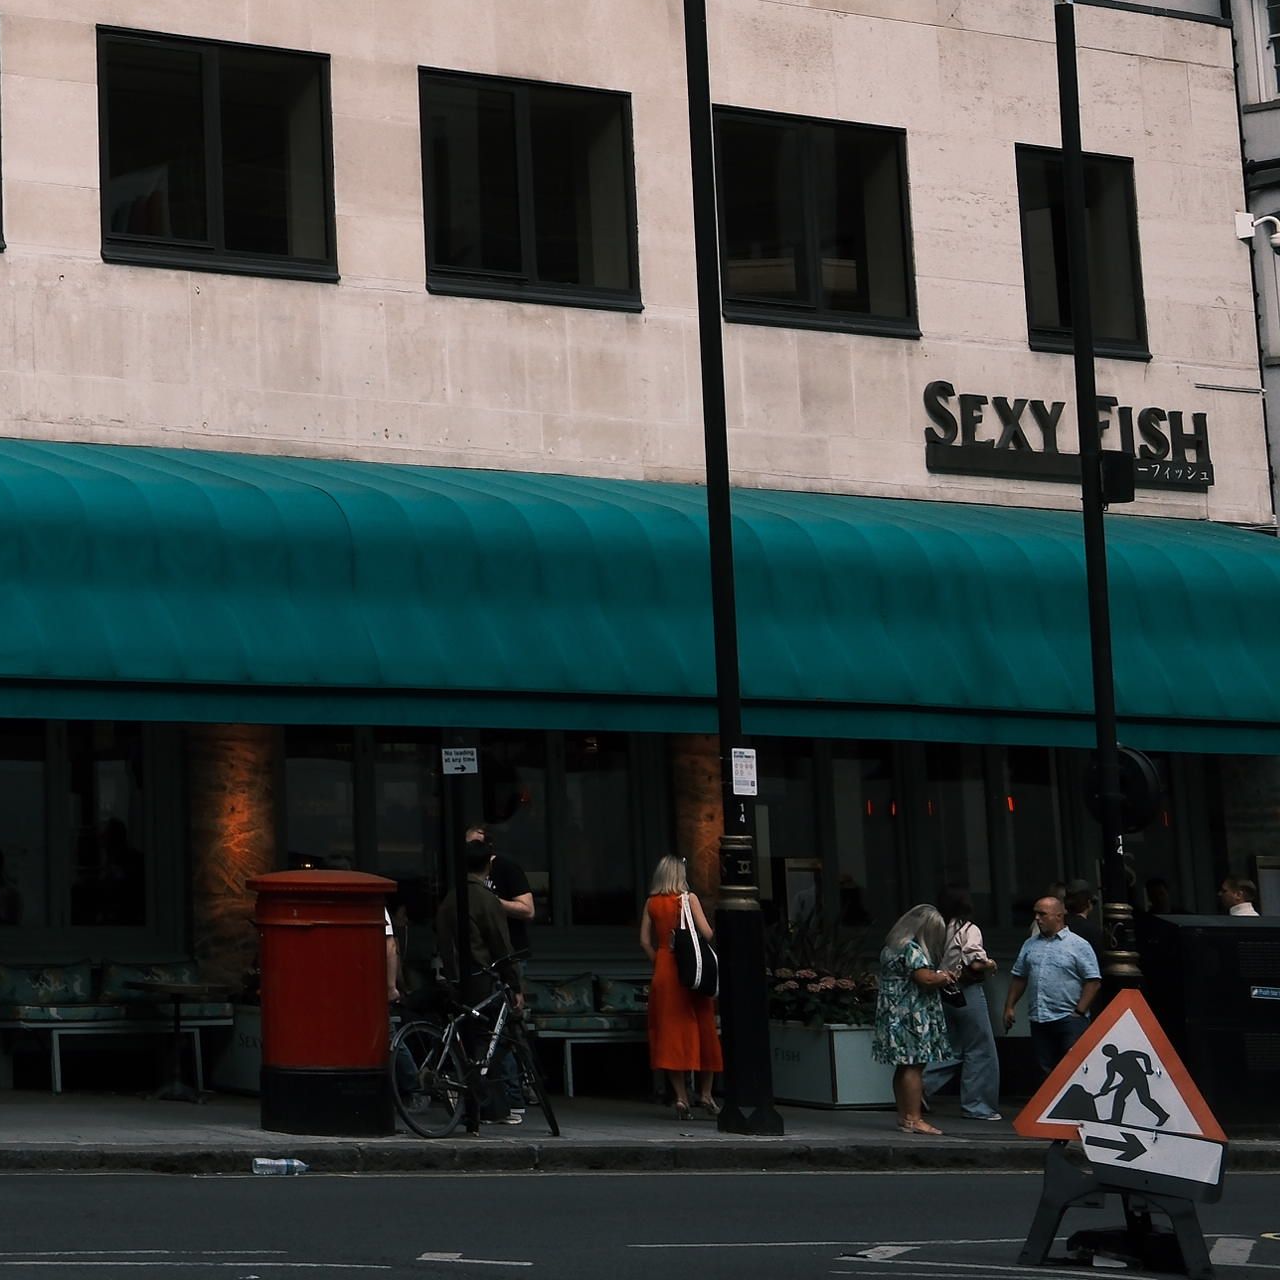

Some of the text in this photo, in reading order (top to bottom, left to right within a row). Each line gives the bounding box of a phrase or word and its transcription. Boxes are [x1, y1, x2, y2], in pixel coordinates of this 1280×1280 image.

[923, 380, 1210, 464] SEXY FISH
[774, 1047, 800, 1062] FISH
